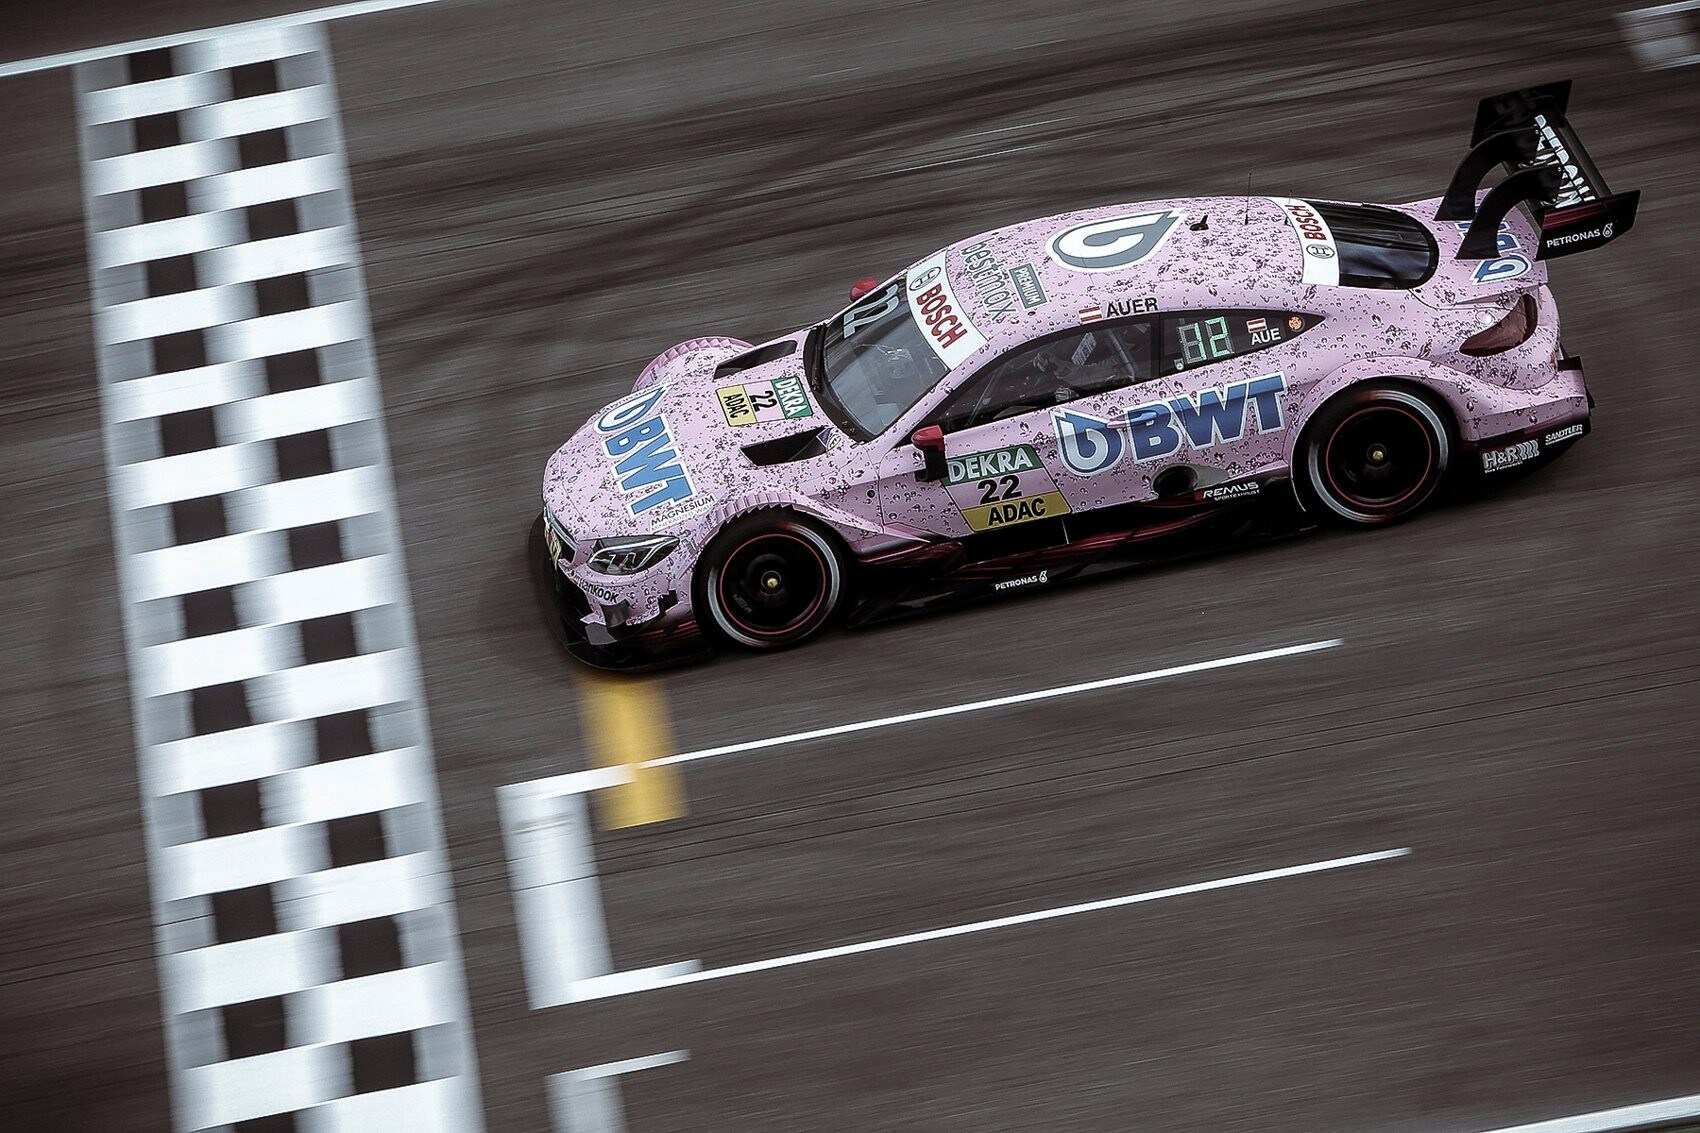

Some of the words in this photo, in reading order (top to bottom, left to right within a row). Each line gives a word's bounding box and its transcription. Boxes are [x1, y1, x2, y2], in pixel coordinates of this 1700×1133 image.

[1285, 204, 1328, 241] BOSCH
[1546, 229, 1601, 249] PETRONAS
[960, 237, 1016, 321] bestmax
[1013, 266, 1042, 305] PREMIUM
[916, 283, 968, 350] BOSCH
[1106, 297, 1159, 318] AUER
[1251, 327, 1281, 346] AUE
[723, 393, 750, 419] ADAC
[749, 390, 777, 412] 22
[774, 377, 809, 417] DEKRA
[1126, 371, 1289, 464] BWT
[1545, 424, 1583, 443] SANDTLER
[603, 413, 695, 517] BWT
[946, 447, 1034, 483] DEKRA
[977, 474, 1023, 506] 22
[1203, 481, 1259, 499] REMUS
[651, 494, 716, 526] MAGNESIUM
[987, 497, 1047, 526] ADAC
[994, 575, 1038, 591] PETRONAS
